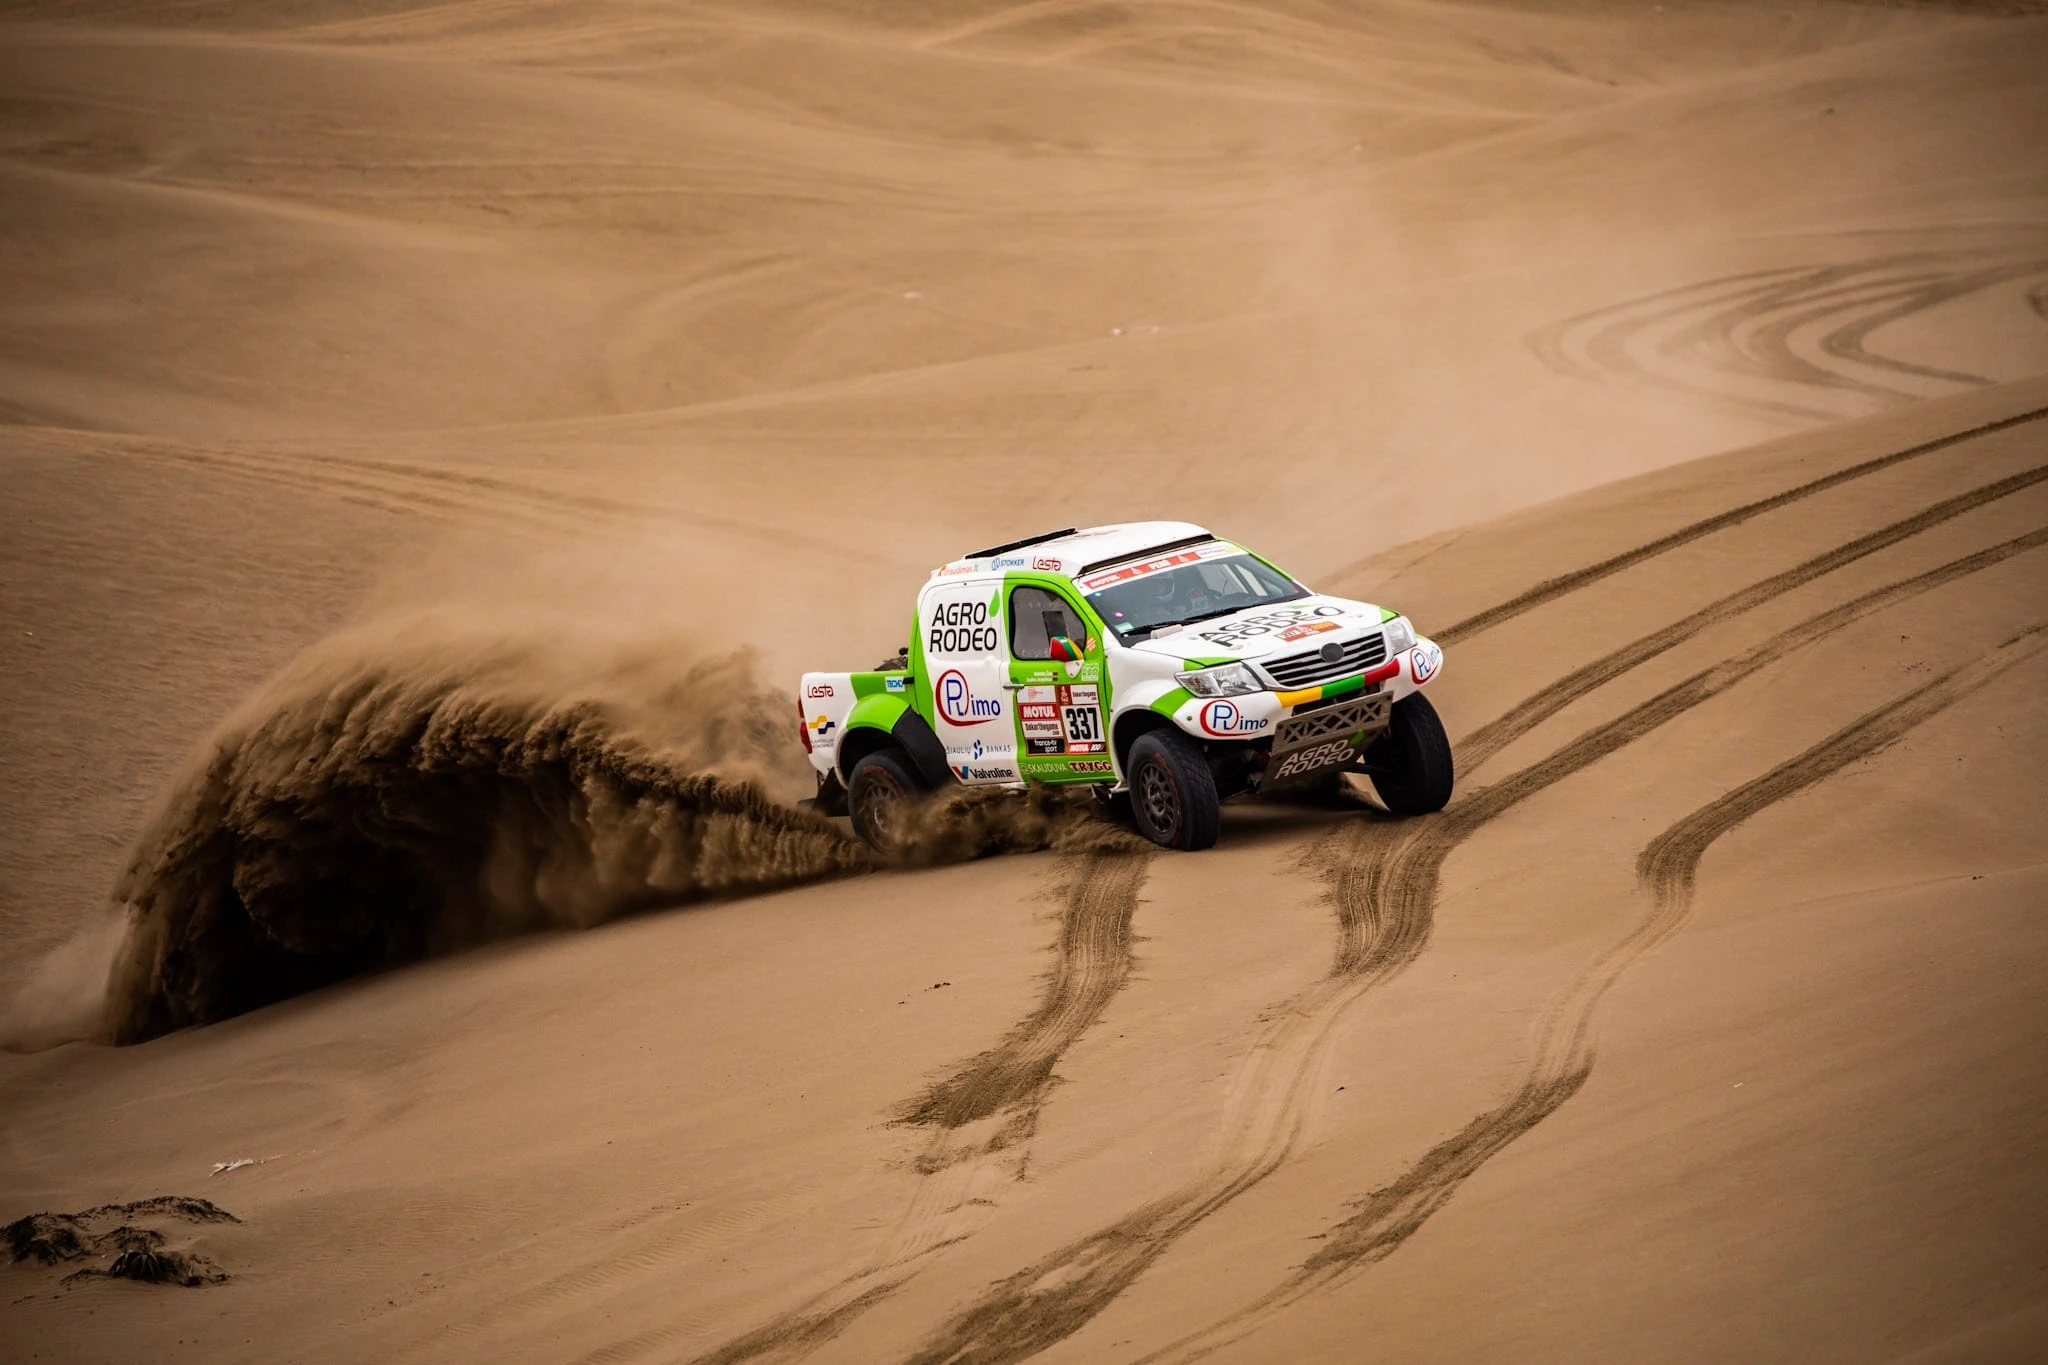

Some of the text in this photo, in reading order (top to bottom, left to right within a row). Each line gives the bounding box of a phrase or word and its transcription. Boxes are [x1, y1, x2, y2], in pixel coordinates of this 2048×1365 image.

[932, 602, 987, 627] AGRO
[1198, 610, 1302, 641] AGRO
[1211, 606, 1345, 647] RODEO
[929, 627, 997, 653] RODEO
[807, 684, 834, 698] Lesta
[1023, 705, 1056, 718] MOTUL
[1065, 707, 1099, 740] 337
[986, 744, 1012, 753] BANKAS
[1282, 739, 1349, 767] AGRO
[969, 767, 1015, 779] Valvoline
[1274, 748, 1355, 780] RODEO
